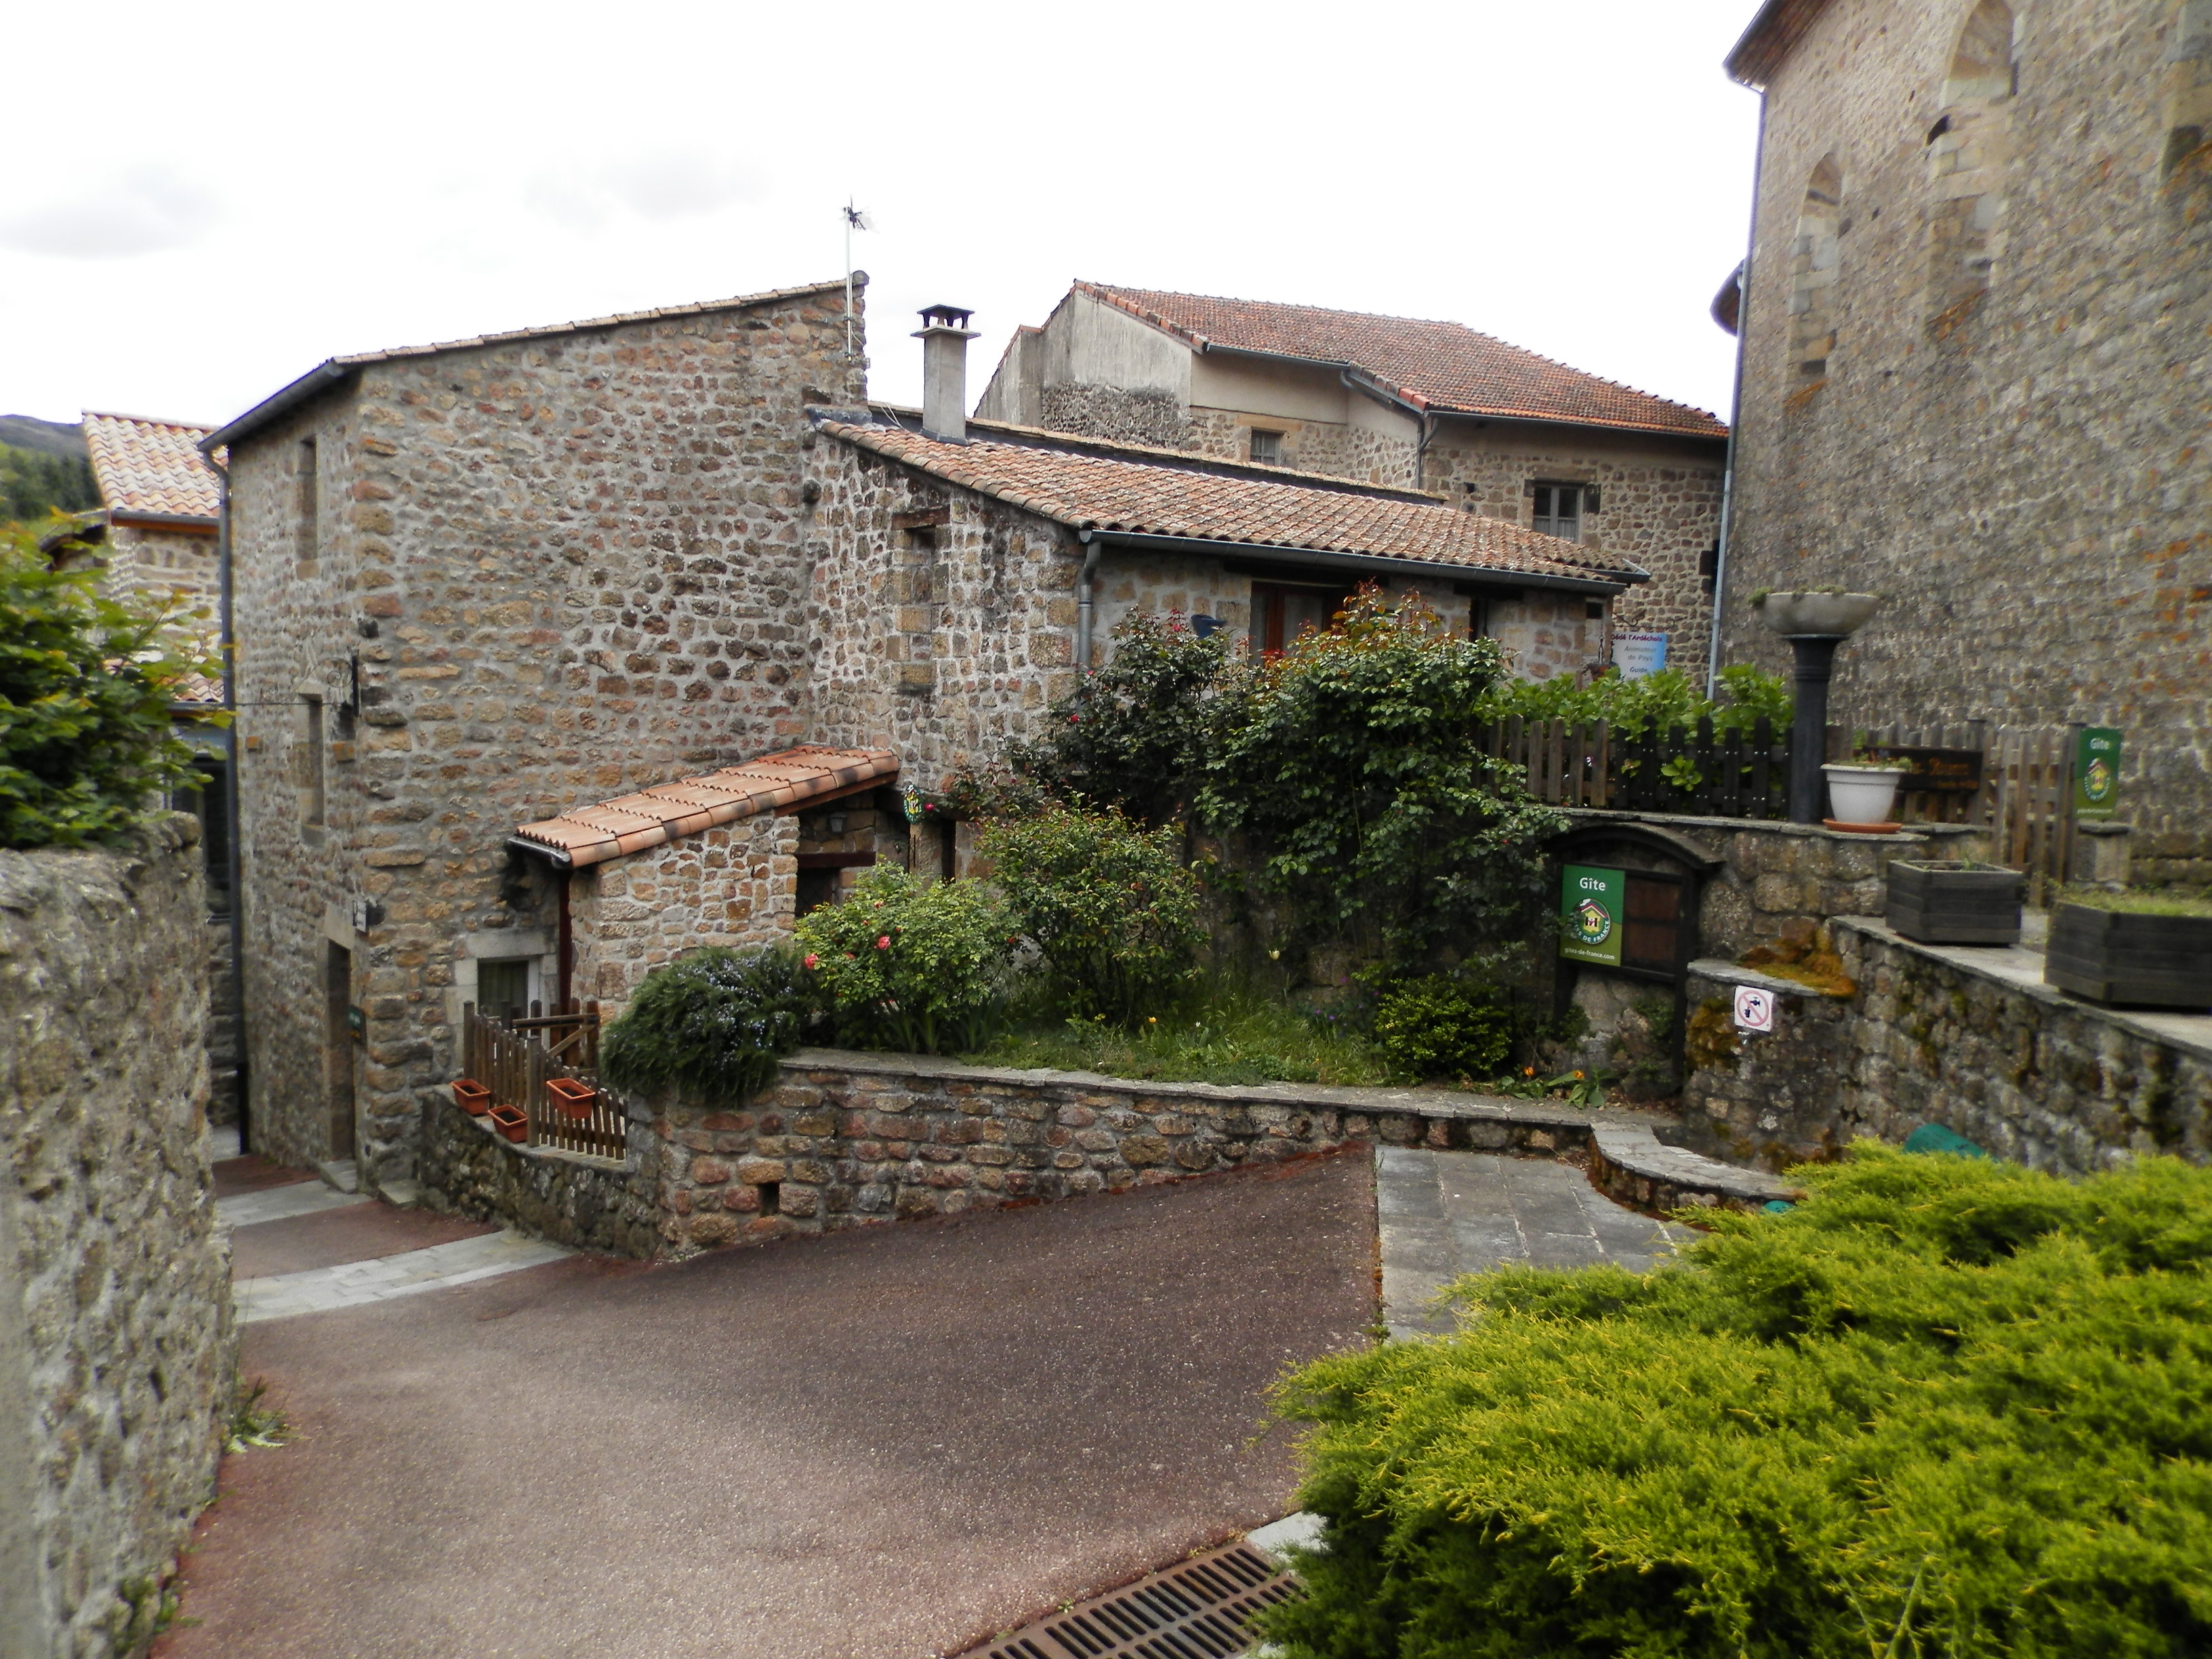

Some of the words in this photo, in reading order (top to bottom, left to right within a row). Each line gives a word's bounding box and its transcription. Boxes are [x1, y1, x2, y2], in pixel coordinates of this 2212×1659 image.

[2091, 738, 2109, 750] Gîte
[1580, 877, 1605, 891] Gîte
[1593, 920, 1610, 942] FRANCE
